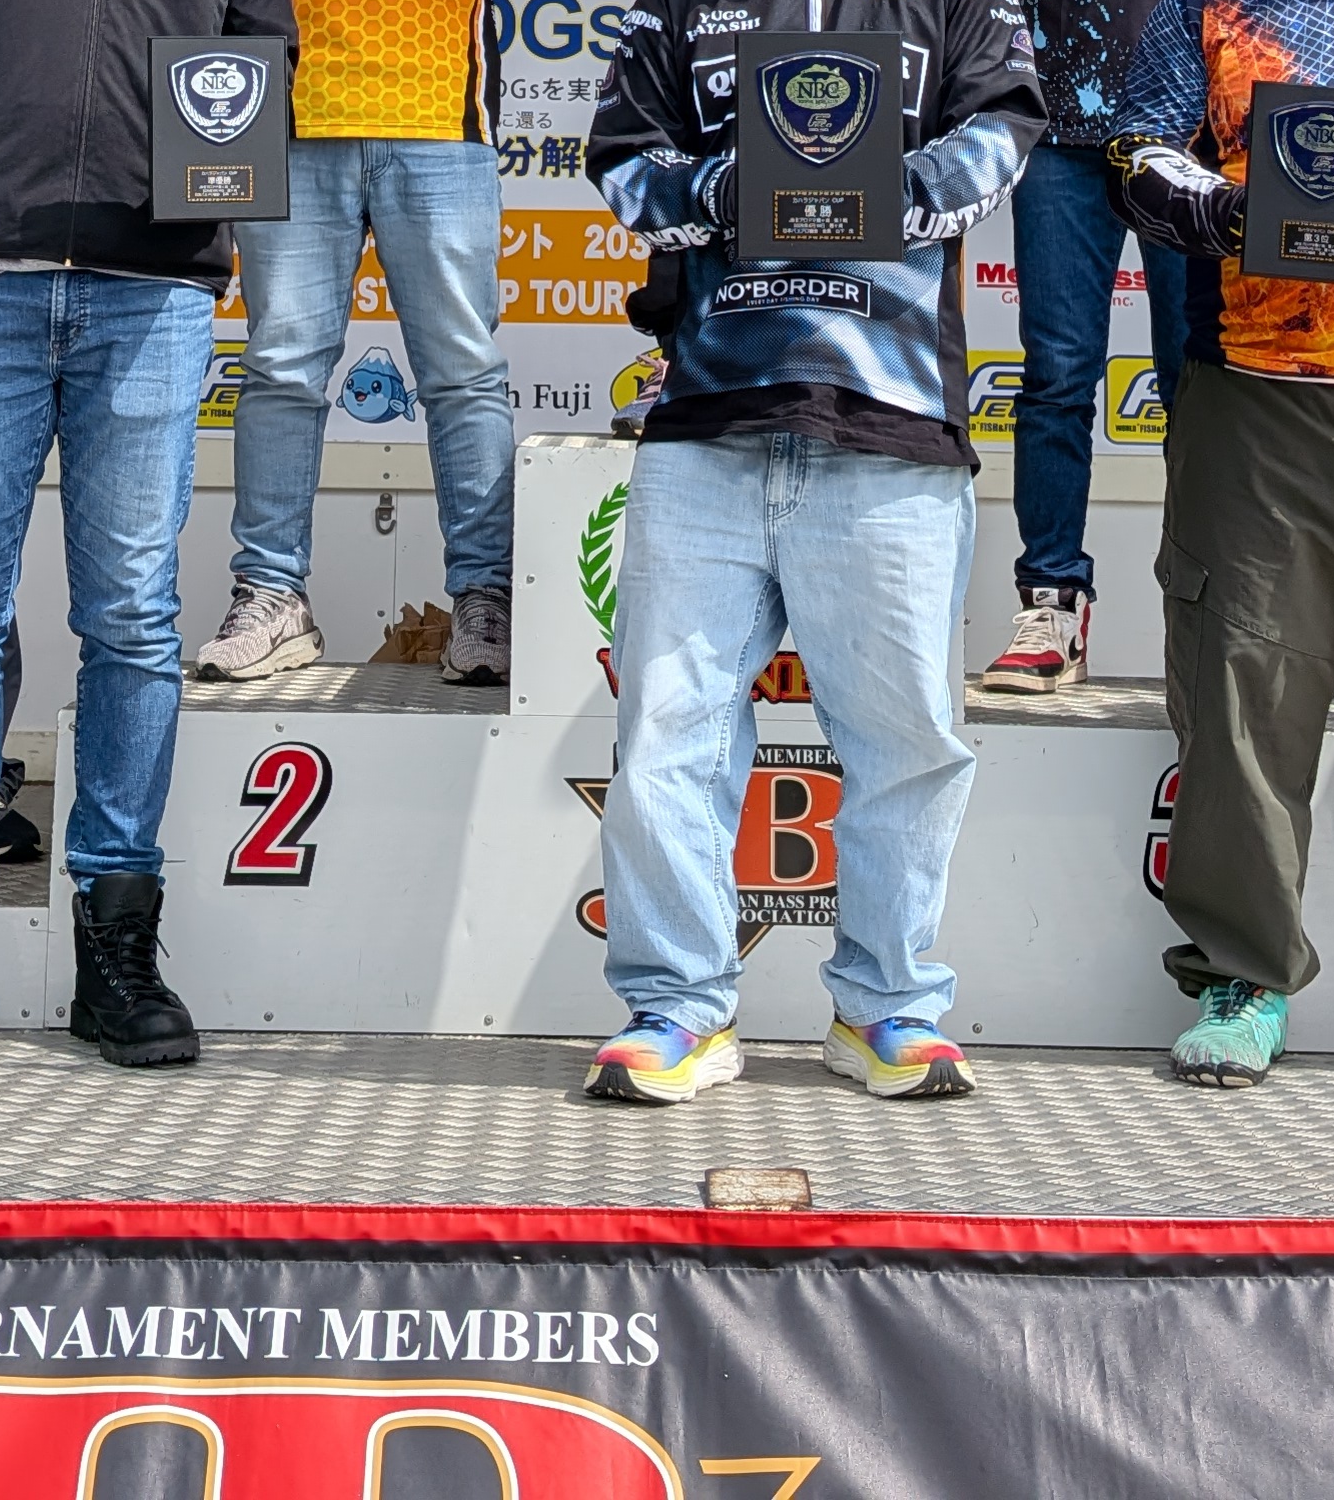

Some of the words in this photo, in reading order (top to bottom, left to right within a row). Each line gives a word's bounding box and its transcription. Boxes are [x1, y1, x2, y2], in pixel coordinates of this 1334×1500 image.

[699, 9, 748, 23] YUGO
[201, 75, 237, 90] NBC
[797, 82, 839, 98] NBC
[499, 136, 587, 178] 分解
[533, 384, 592, 416] Fuji
[224, 742, 333, 886] 2
[763, 895, 807, 909] BASS
[317, 1305, 662, 1368] MEMBERS
